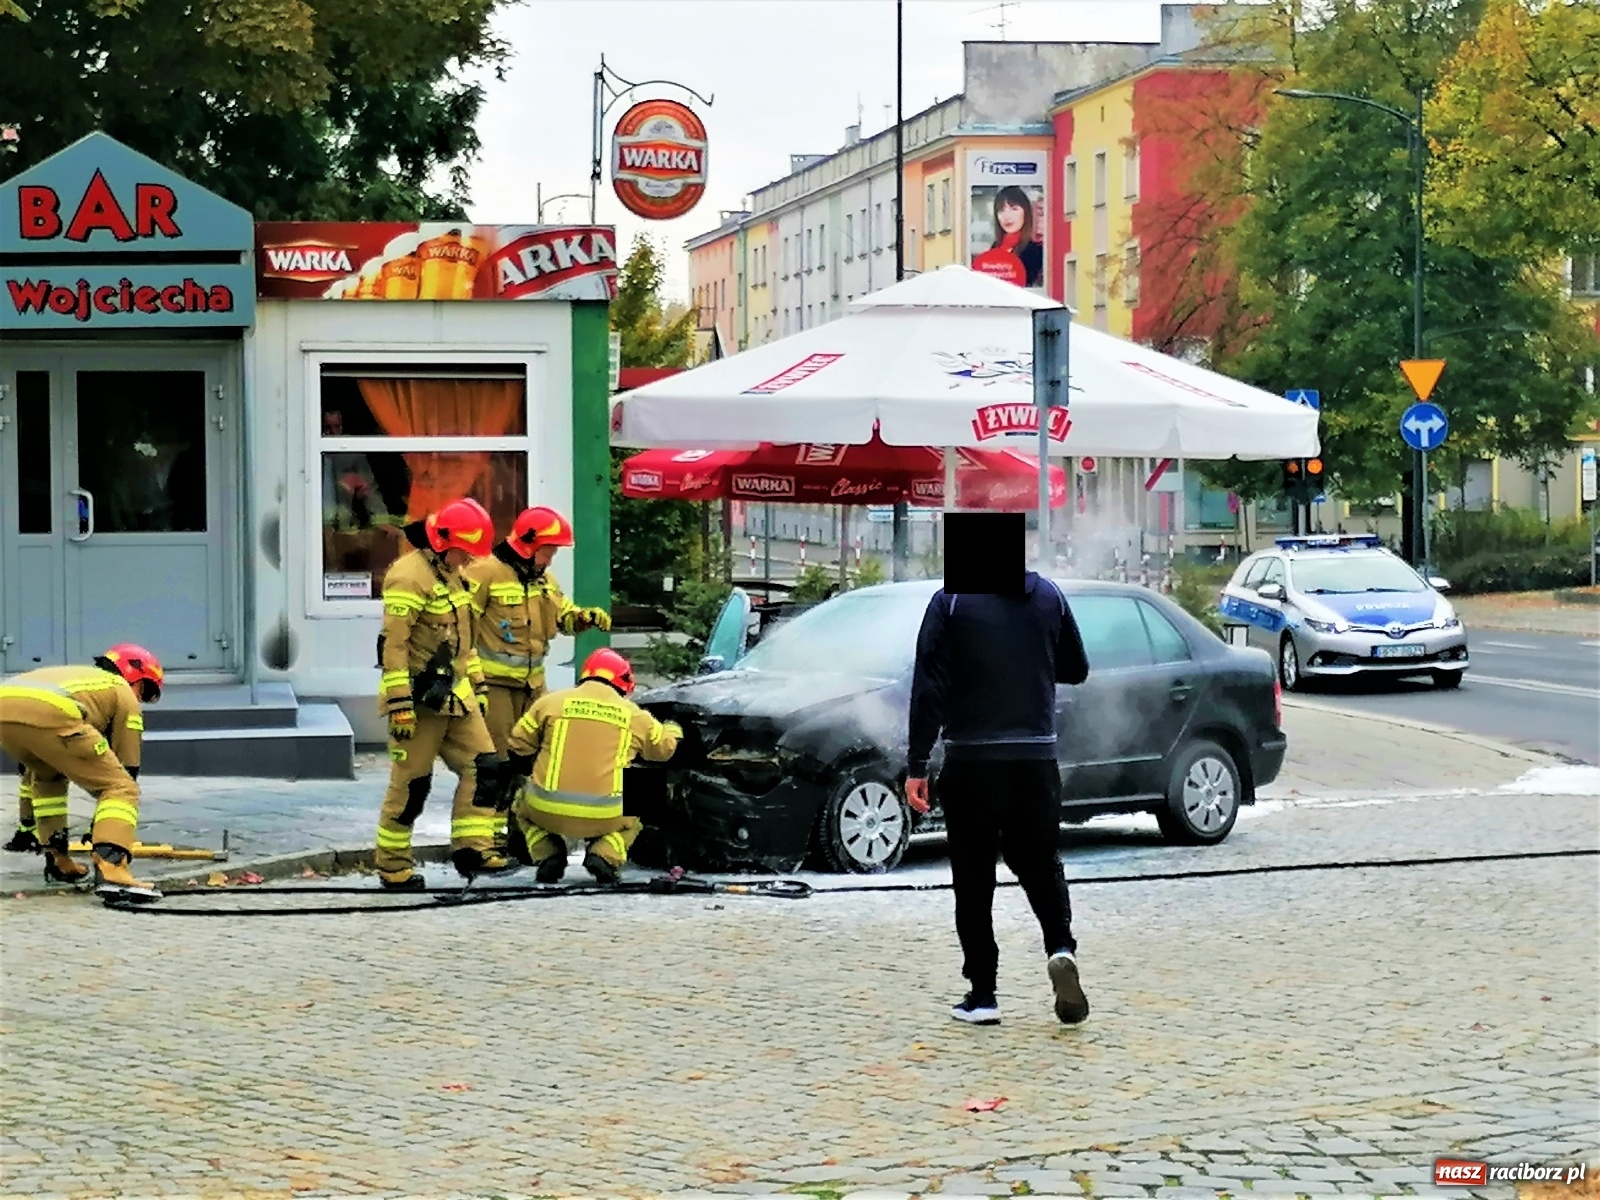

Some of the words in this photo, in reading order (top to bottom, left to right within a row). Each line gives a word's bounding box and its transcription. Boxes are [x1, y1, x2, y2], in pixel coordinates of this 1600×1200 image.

[623, 147, 699, 171] WARKA
[18, 167, 183, 243] BAR
[267, 249, 353, 272] WARKA
[5, 277, 234, 322] Wojciecha
[984, 404, 1061, 430] ŻYWIC
[735, 476, 791, 493] WARKA
[830, 476, 884, 497] Classic
